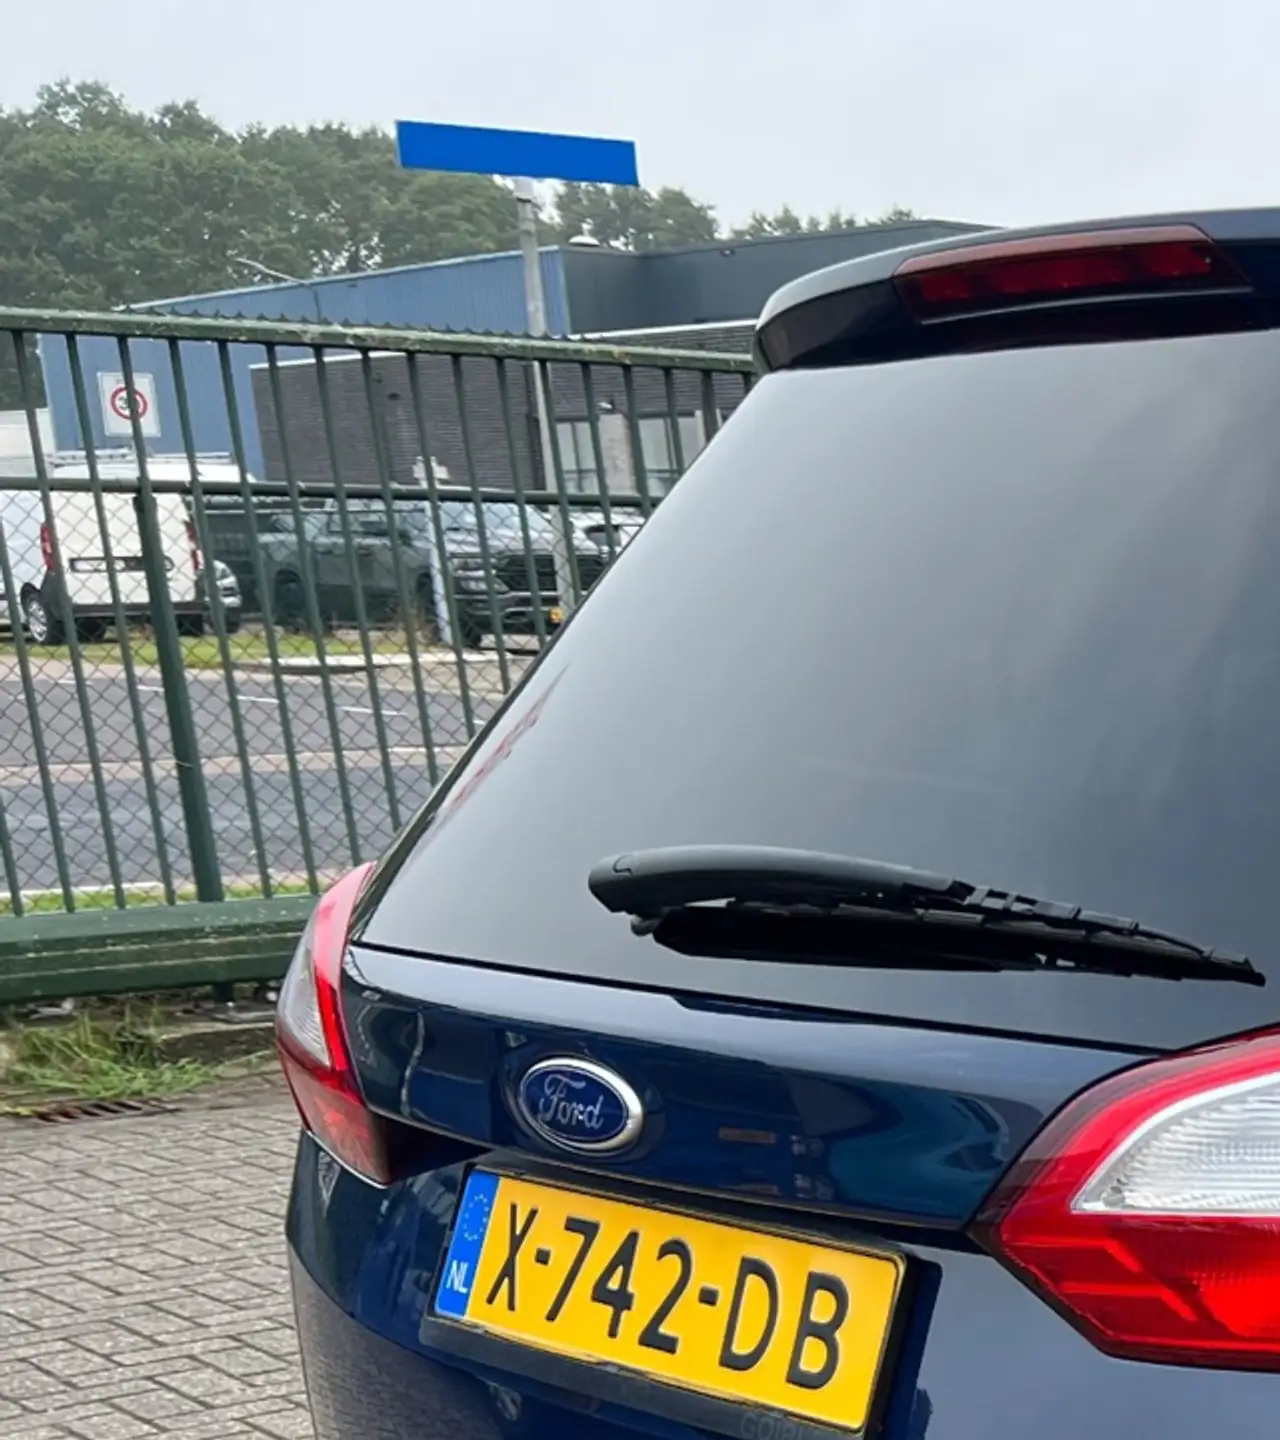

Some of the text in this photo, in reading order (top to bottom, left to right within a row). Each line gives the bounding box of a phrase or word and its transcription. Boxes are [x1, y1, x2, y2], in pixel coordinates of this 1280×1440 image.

[537, 1071, 605, 1131] Ford
[445, 1259, 469, 1294] NL
[485, 1200, 850, 1390] X-742-DB
